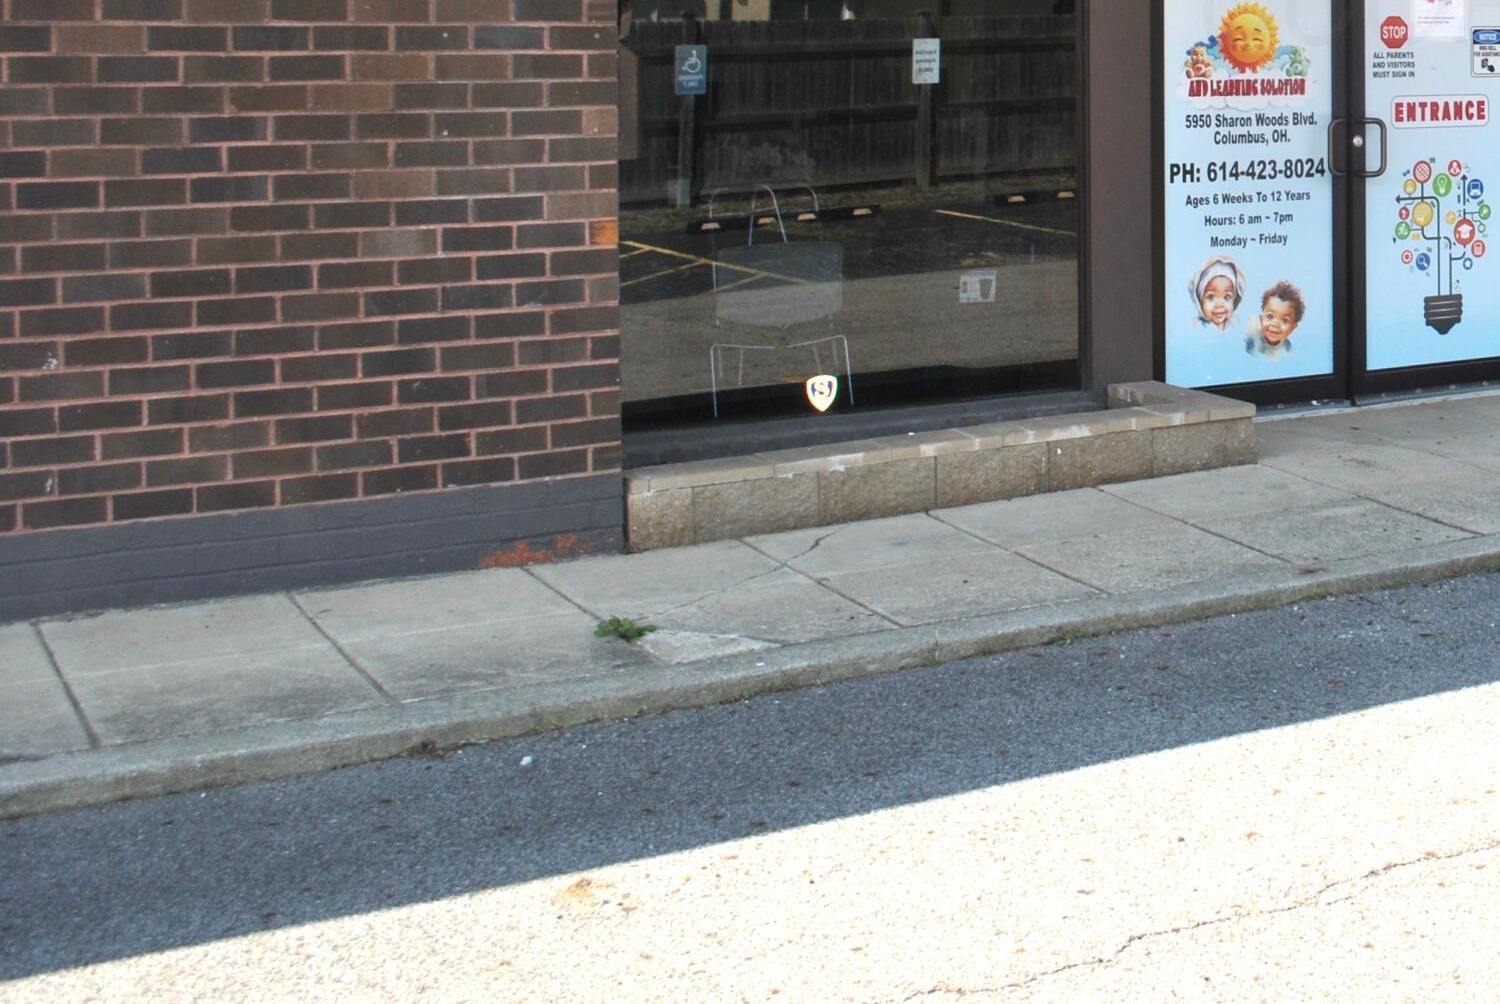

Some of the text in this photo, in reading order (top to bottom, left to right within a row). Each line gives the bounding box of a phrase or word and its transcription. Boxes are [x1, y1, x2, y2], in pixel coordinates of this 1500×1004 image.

[1382, 26, 1406, 39] STOP
[1373, 51, 1414, 59] ALL PARENTS
[1372, 61, 1415, 69] AND VISITORS
[1408, 70, 1415, 78] IN
[1188, 79, 1209, 97] AND
[1210, 78, 1259, 97] LEARNING
[1393, 99, 1487, 124] ENTRANCE
[1185, 112, 1317, 129] 5950 Sharon Woods Blvd.
[1213, 129, 1291, 146] Columbus, OH.
[1169, 157, 1326, 184] PH: 614-423-8024
[1185, 190, 1311, 209] Ages 6 Weeks To 12 Years
[1204, 215, 1236, 227] Hours:
[1238, 213, 1245, 225] 6
[1247, 215, 1262, 225] am
[1273, 212, 1293, 225] 7pm
[1210, 235, 1248, 248] Monday
[1259, 233, 1288, 246] Friday
